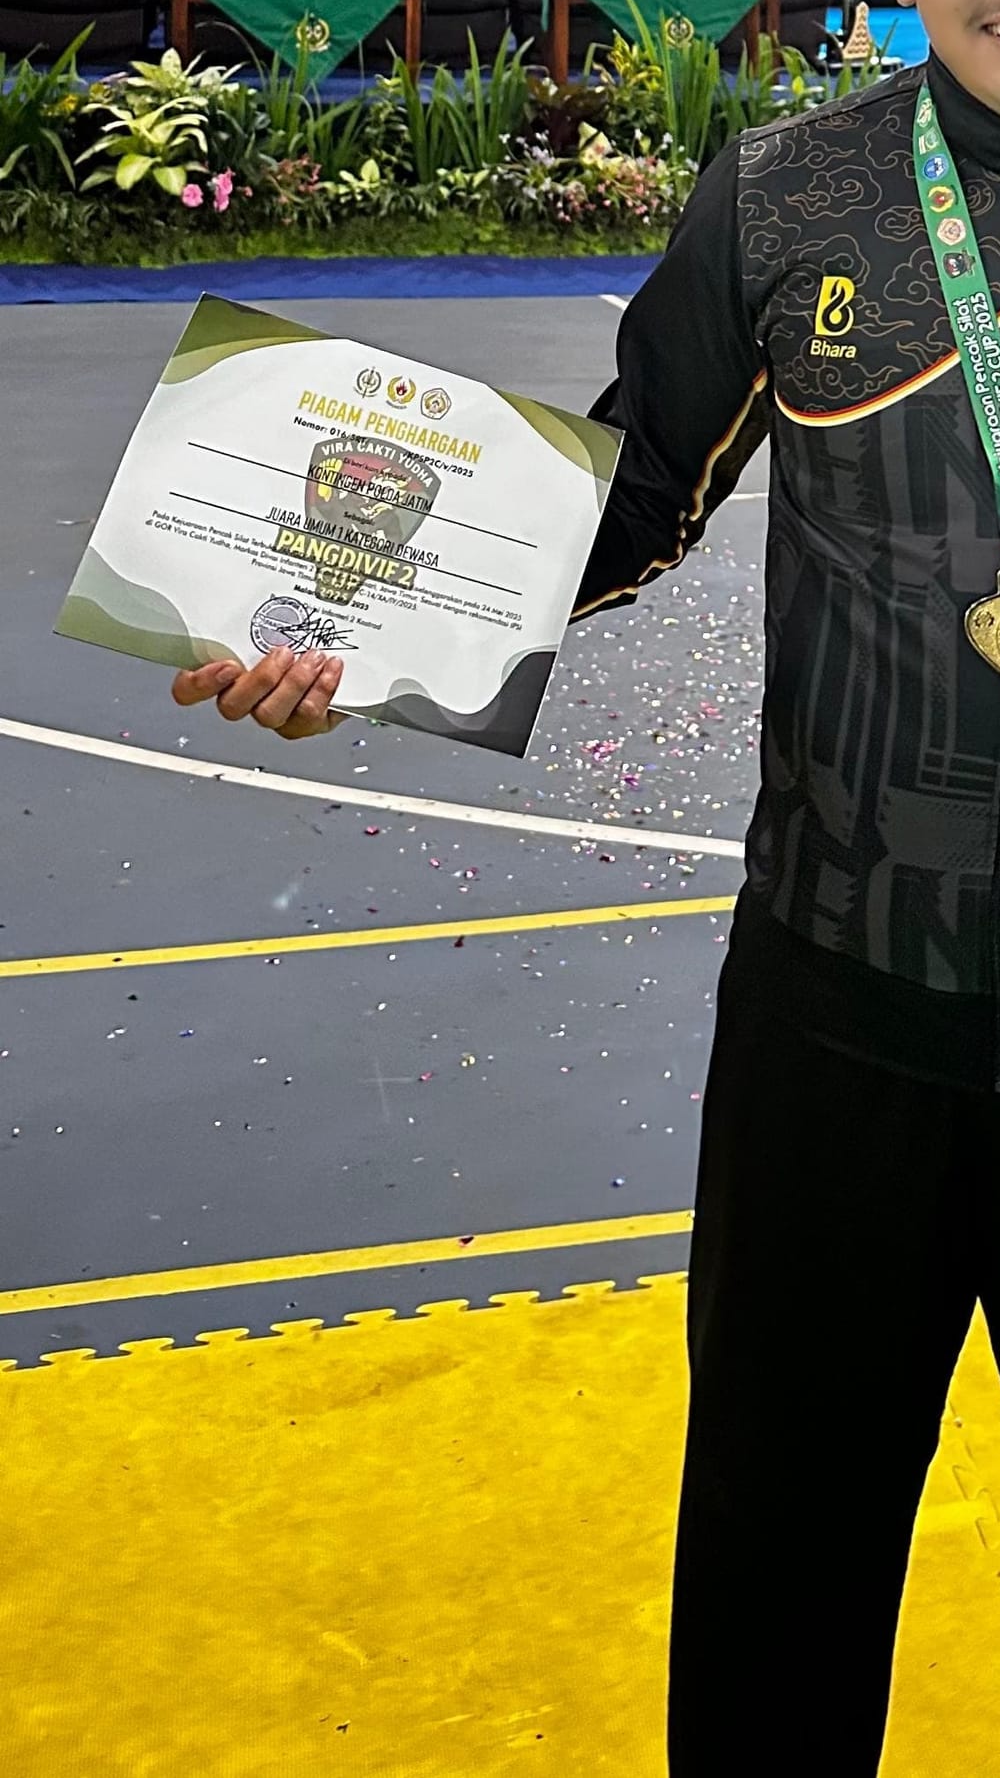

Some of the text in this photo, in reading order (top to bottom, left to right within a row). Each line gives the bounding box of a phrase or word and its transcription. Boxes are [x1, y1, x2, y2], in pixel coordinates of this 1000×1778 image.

[952, 298, 974, 332] Silat
[970, 292, 994, 333] 2025
[810, 339, 857, 358] Bhara
[963, 334, 989, 394] Pencak
[298, 390, 483, 464] PIAGAM PENGHARGAAN
[321, 441, 434, 488] VIRA CAKTI YUDHA
[401, 494, 433, 512] JATIM
[266, 506, 301, 527] JUARA
[303, 518, 336, 536] UMUM
[344, 528, 394, 553] KATEGORI
[396, 544, 439, 567] DEWASA
[276, 529, 400, 579] PANGDIVIF
[398, 565, 414, 585] 2
